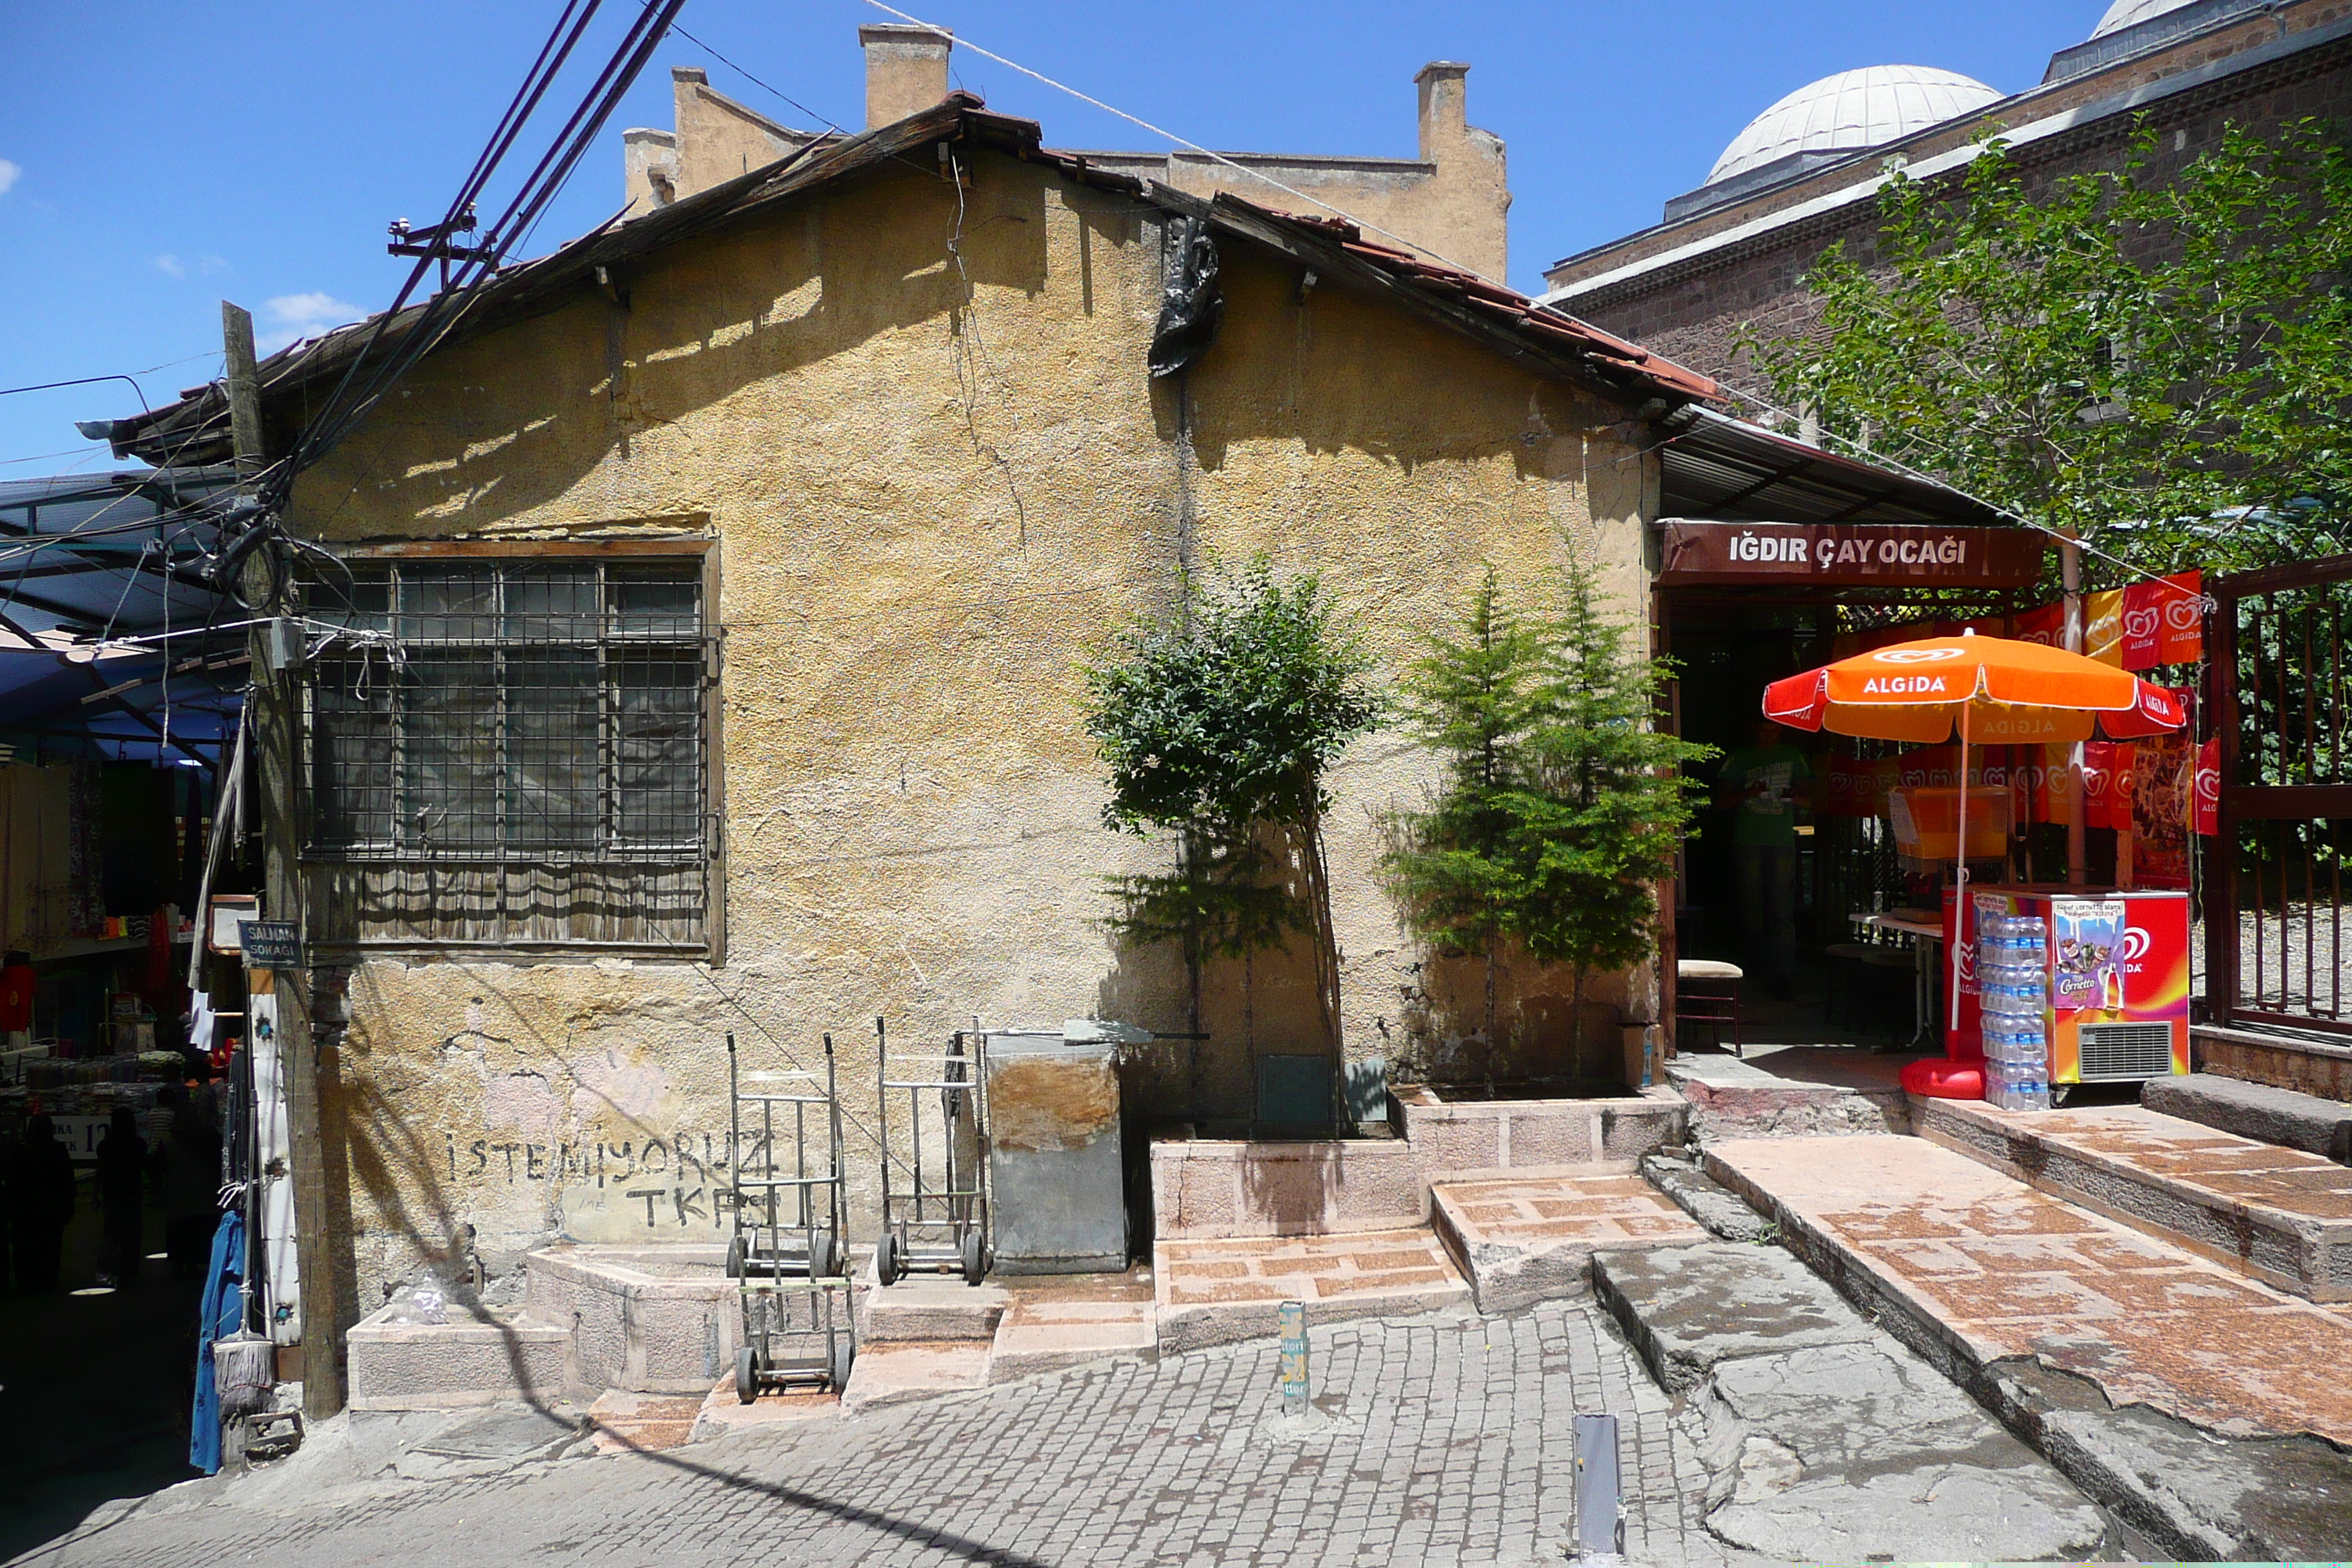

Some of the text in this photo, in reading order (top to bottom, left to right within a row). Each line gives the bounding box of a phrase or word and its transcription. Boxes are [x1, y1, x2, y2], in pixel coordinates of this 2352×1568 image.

[1730, 531, 1966, 569] IĞDIR ÇAY OCAĞI
[248, 927, 295, 941] SALMAN
[250, 944, 294, 956] SOKAĞI
[2059, 979, 2095, 995] Cornetto
